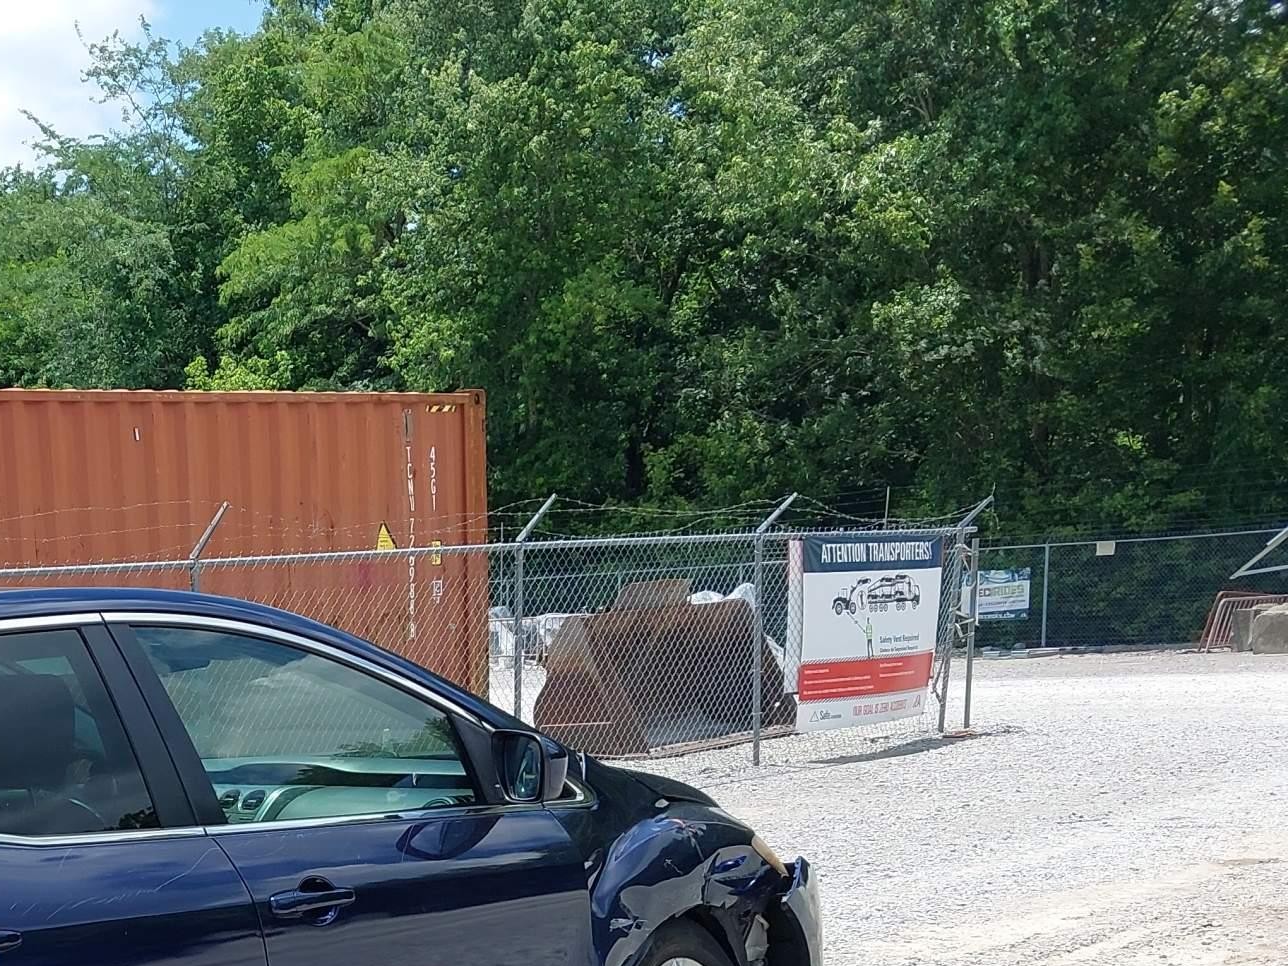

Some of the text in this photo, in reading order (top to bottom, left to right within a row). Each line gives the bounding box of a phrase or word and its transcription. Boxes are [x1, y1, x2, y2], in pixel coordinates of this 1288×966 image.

[428, 446, 437, 512] 45G1
[821, 541, 932, 563] ATTENTION TRANSPORTERS!
